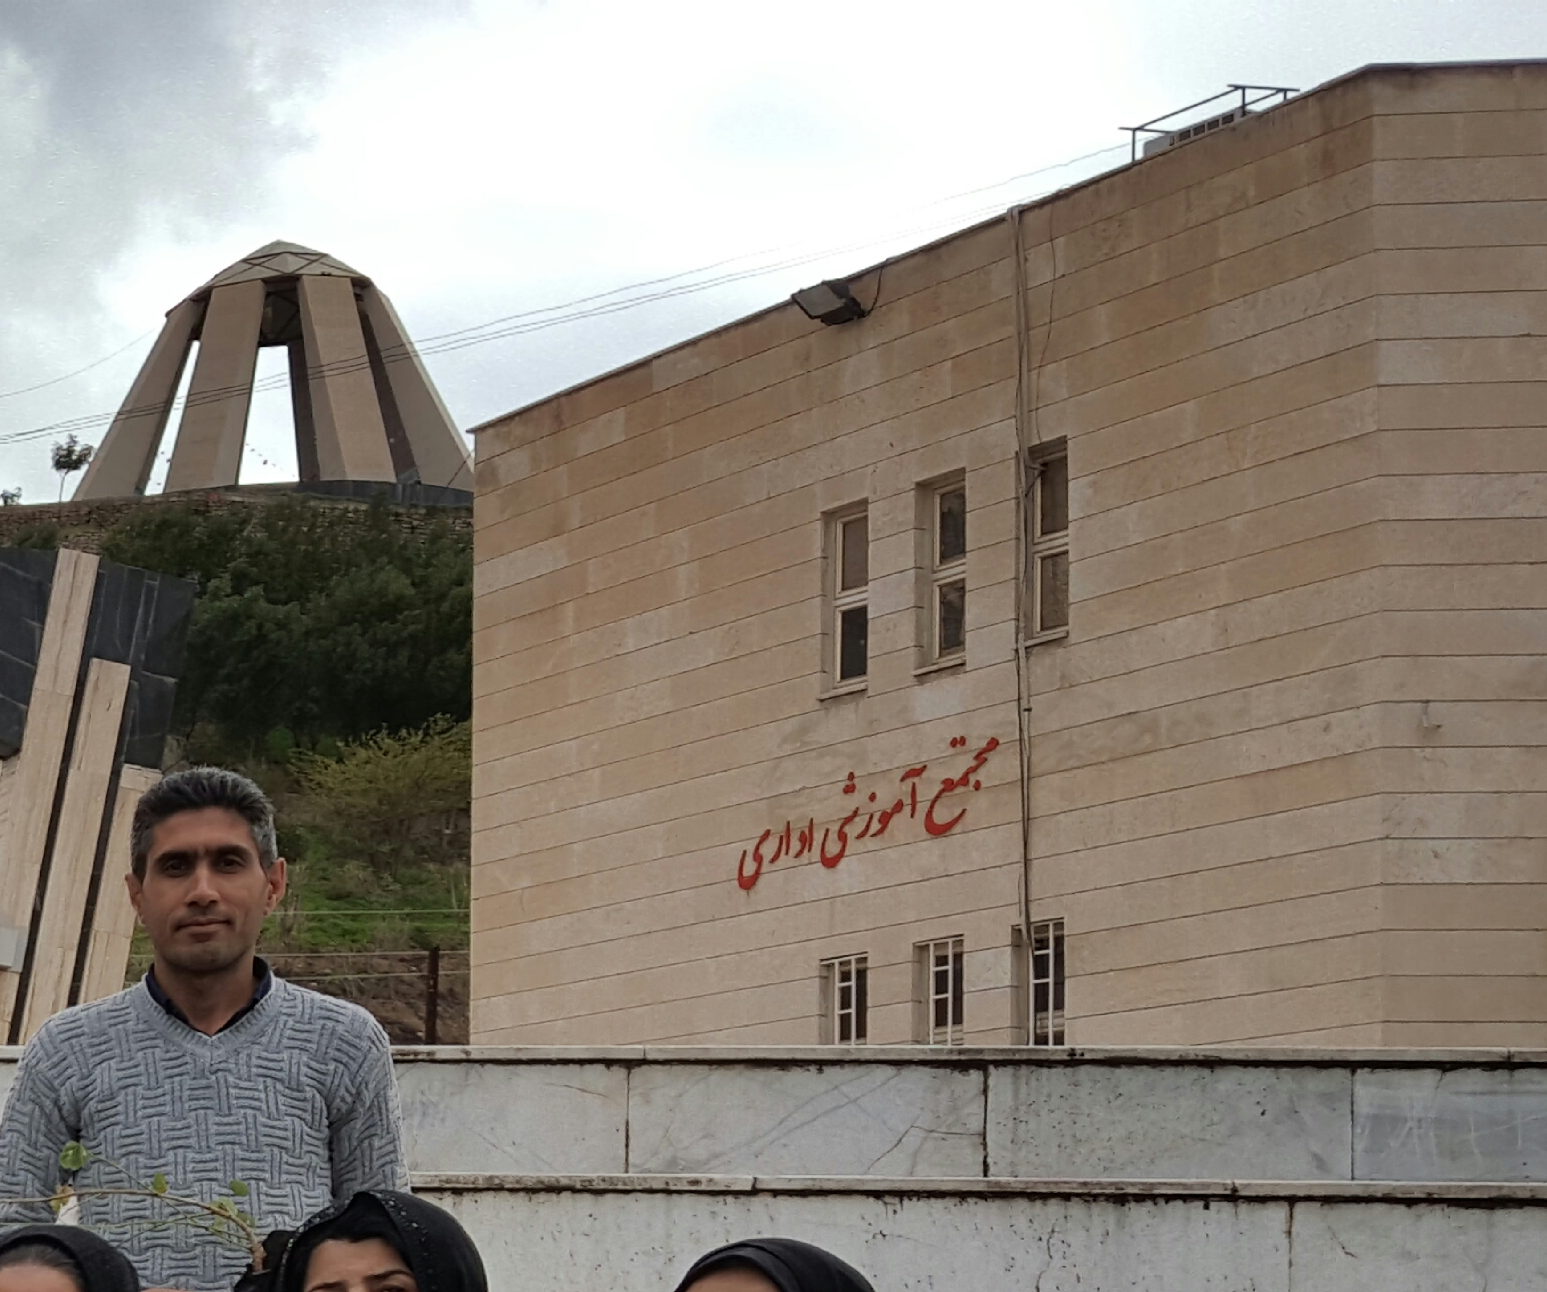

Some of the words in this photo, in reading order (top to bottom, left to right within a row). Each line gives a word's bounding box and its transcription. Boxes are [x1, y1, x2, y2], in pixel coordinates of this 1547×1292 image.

[820, 765, 927, 868] آموزشی
[925, 736, 1000, 836] مجتمع
[737, 818, 814, 890] اداری
